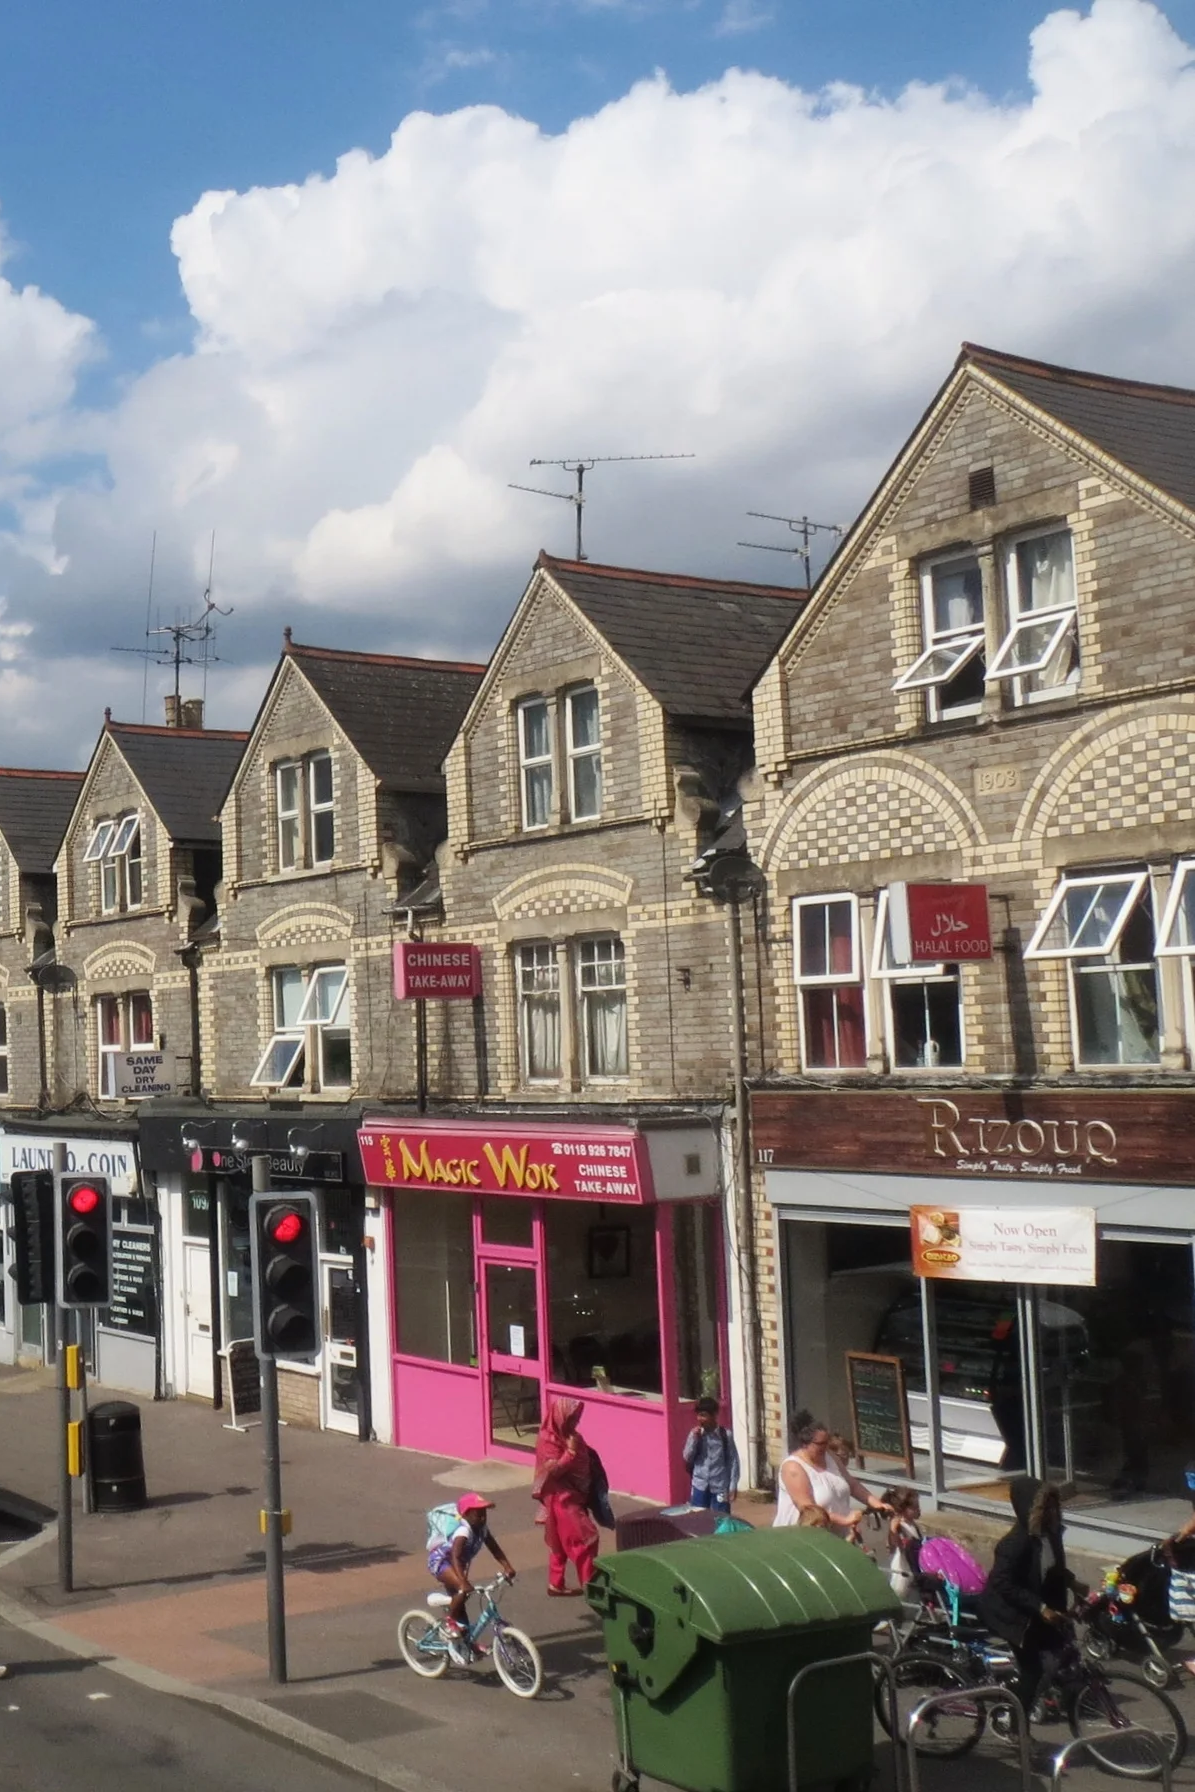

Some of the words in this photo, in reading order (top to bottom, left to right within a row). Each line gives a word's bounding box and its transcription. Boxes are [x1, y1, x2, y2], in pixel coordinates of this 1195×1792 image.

[979, 769, 1017, 792] 1903
[931, 913, 969, 936] حلال
[915, 940, 952, 953] HALAL
[955, 940, 987, 952] FOOD
[407, 953, 471, 966] CHINESE
[408, 975, 471, 988] TAKE-AWAY
[126, 1056, 163, 1066] SAME
[133, 1066, 157, 1075] DAY
[135, 1076, 155, 1084] DRY
[121, 1084, 171, 1093] CLEANING
[359, 1136, 373, 1147] 115
[563, 1144, 586, 1156] 0118
[607, 1146, 631, 1157] 7847
[757, 1149, 774, 1163] 117
[578, 1163, 628, 1178] CHINESE
[956, 1160, 987, 1172] Simply
[1020, 1162, 1053, 1174] Simply
[1057, 1163, 1082, 1174] Fresh
[574, 1181, 637, 1196] TAKE-AWAY
[993, 1223, 1020, 1236] Now
[1023, 1224, 1058, 1239] Open
[122, 1240, 151, 1252] CLEANERS
[969, 1241, 997, 1253] Simply
[1027, 1243, 1060, 1255] Simply
[1062, 1244, 1088, 1255] Fresh
